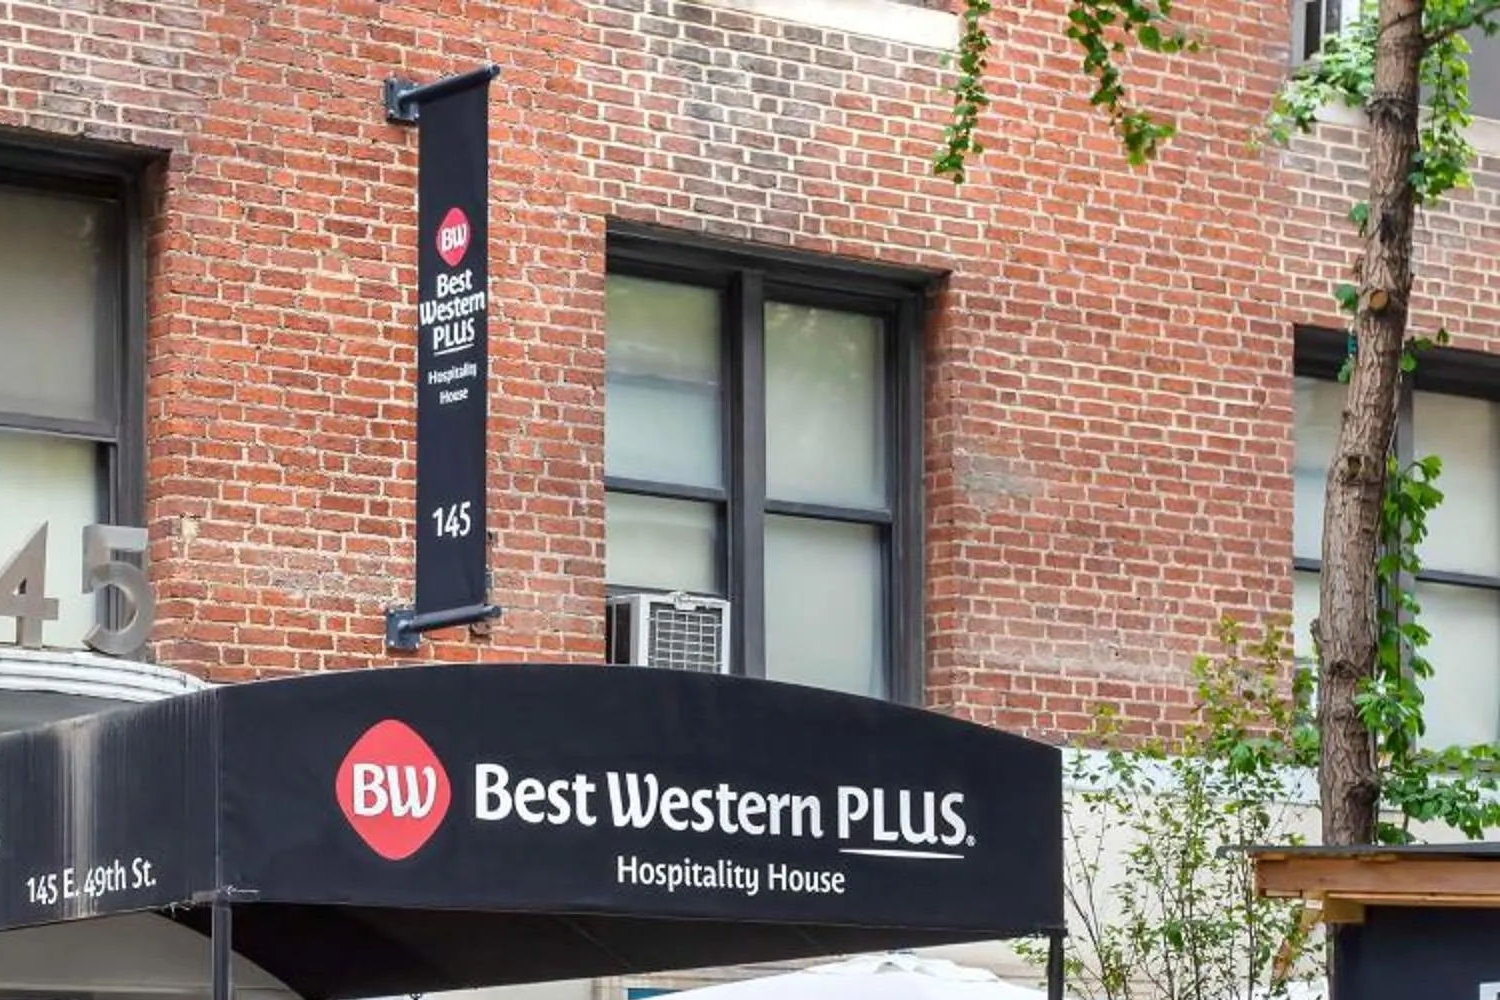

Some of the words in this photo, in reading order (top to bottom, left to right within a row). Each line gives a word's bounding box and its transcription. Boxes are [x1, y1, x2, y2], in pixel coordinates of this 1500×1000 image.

[441, 224, 467, 251] BW
[436, 269, 473, 298] Best
[419, 291, 486, 325] Western
[432, 317, 475, 350] PLUS
[428, 362, 477, 385] Hospitality
[439, 388, 469, 405] House
[432, 501, 471, 538] 145
[353, 762, 437, 818] BW
[475, 763, 597, 827] Best
[607, 772, 824, 840] Western
[26, 873, 58, 905] 145
[63, 867, 80, 899] E.
[84, 859, 127, 897] 49th
[131, 857, 157, 889] St.
[617, 855, 759, 896] Hospitality
[768, 863, 845, 894] House
